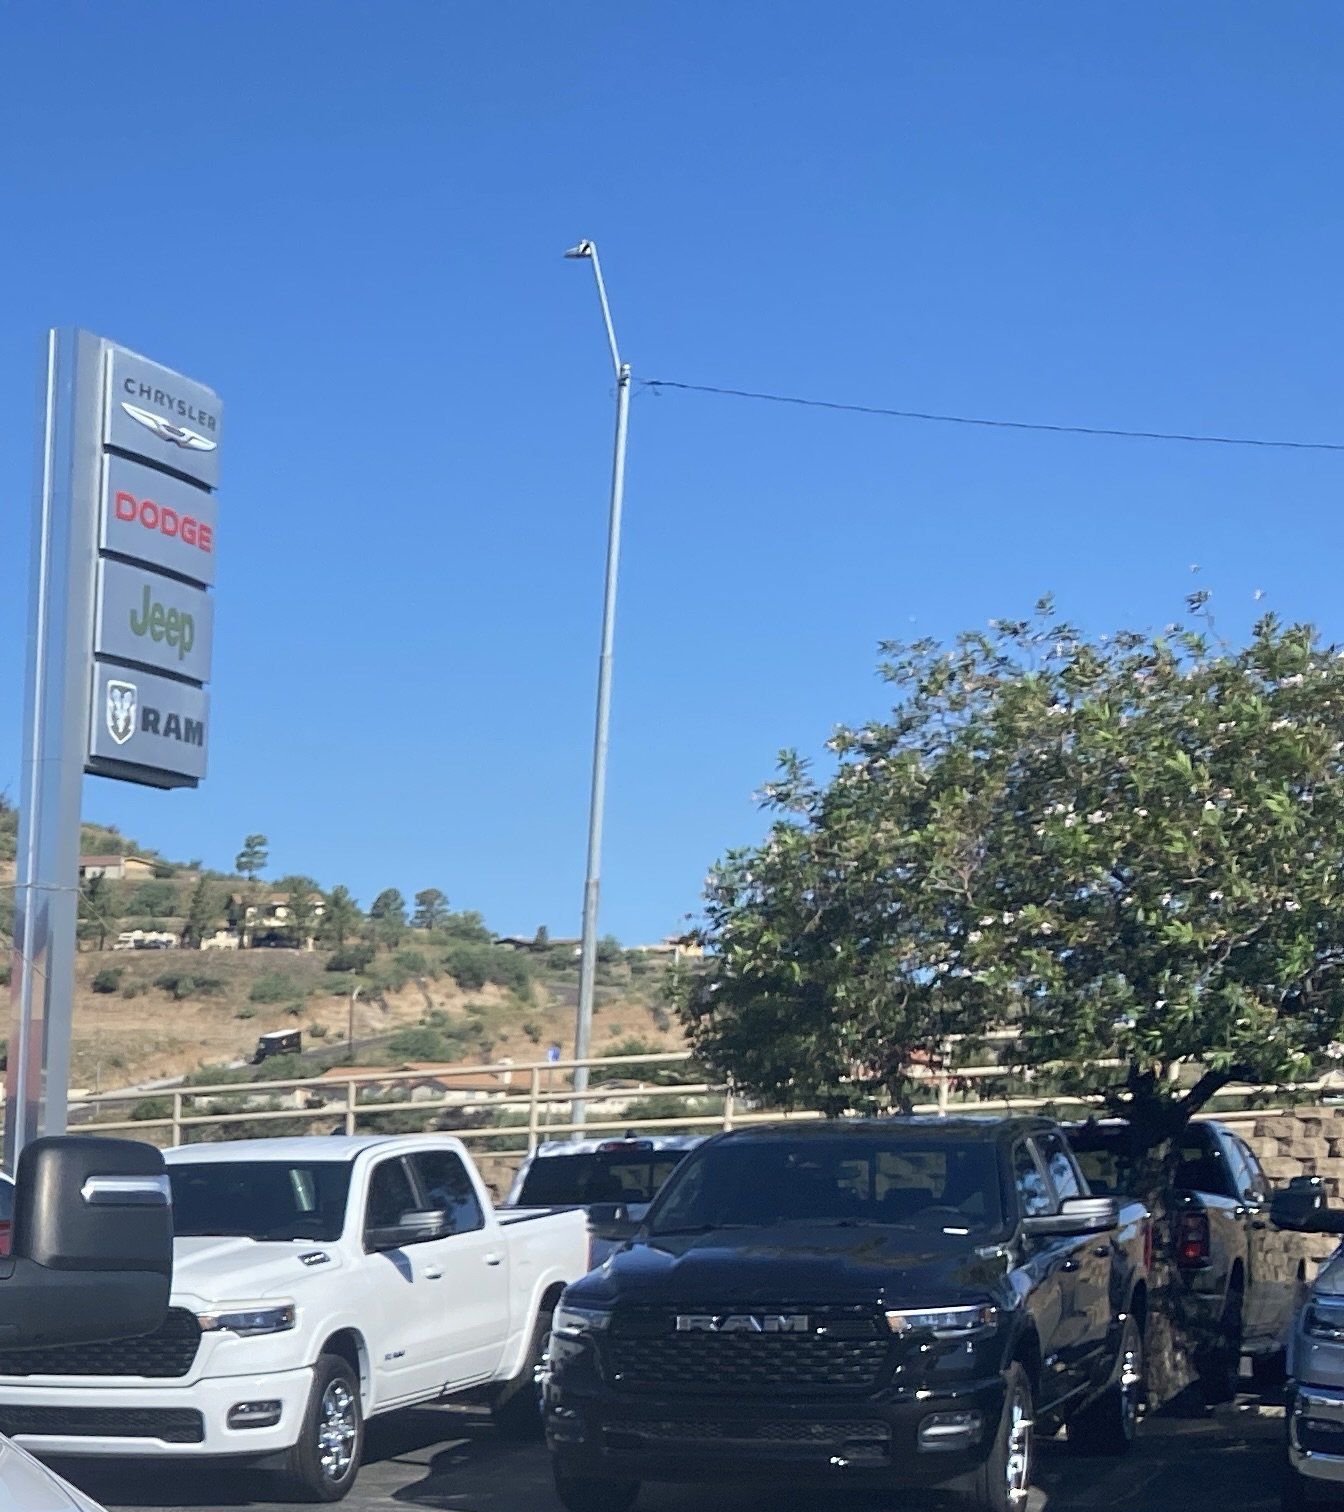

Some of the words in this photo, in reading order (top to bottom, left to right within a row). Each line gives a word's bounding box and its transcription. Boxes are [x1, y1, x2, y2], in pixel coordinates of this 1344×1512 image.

[124, 378, 217, 432] CHRYSLER
[115, 491, 212, 553] DODGE
[129, 584, 195, 660] Jeep
[141, 705, 204, 747] RAM
[676, 1314, 809, 1332] RAM
